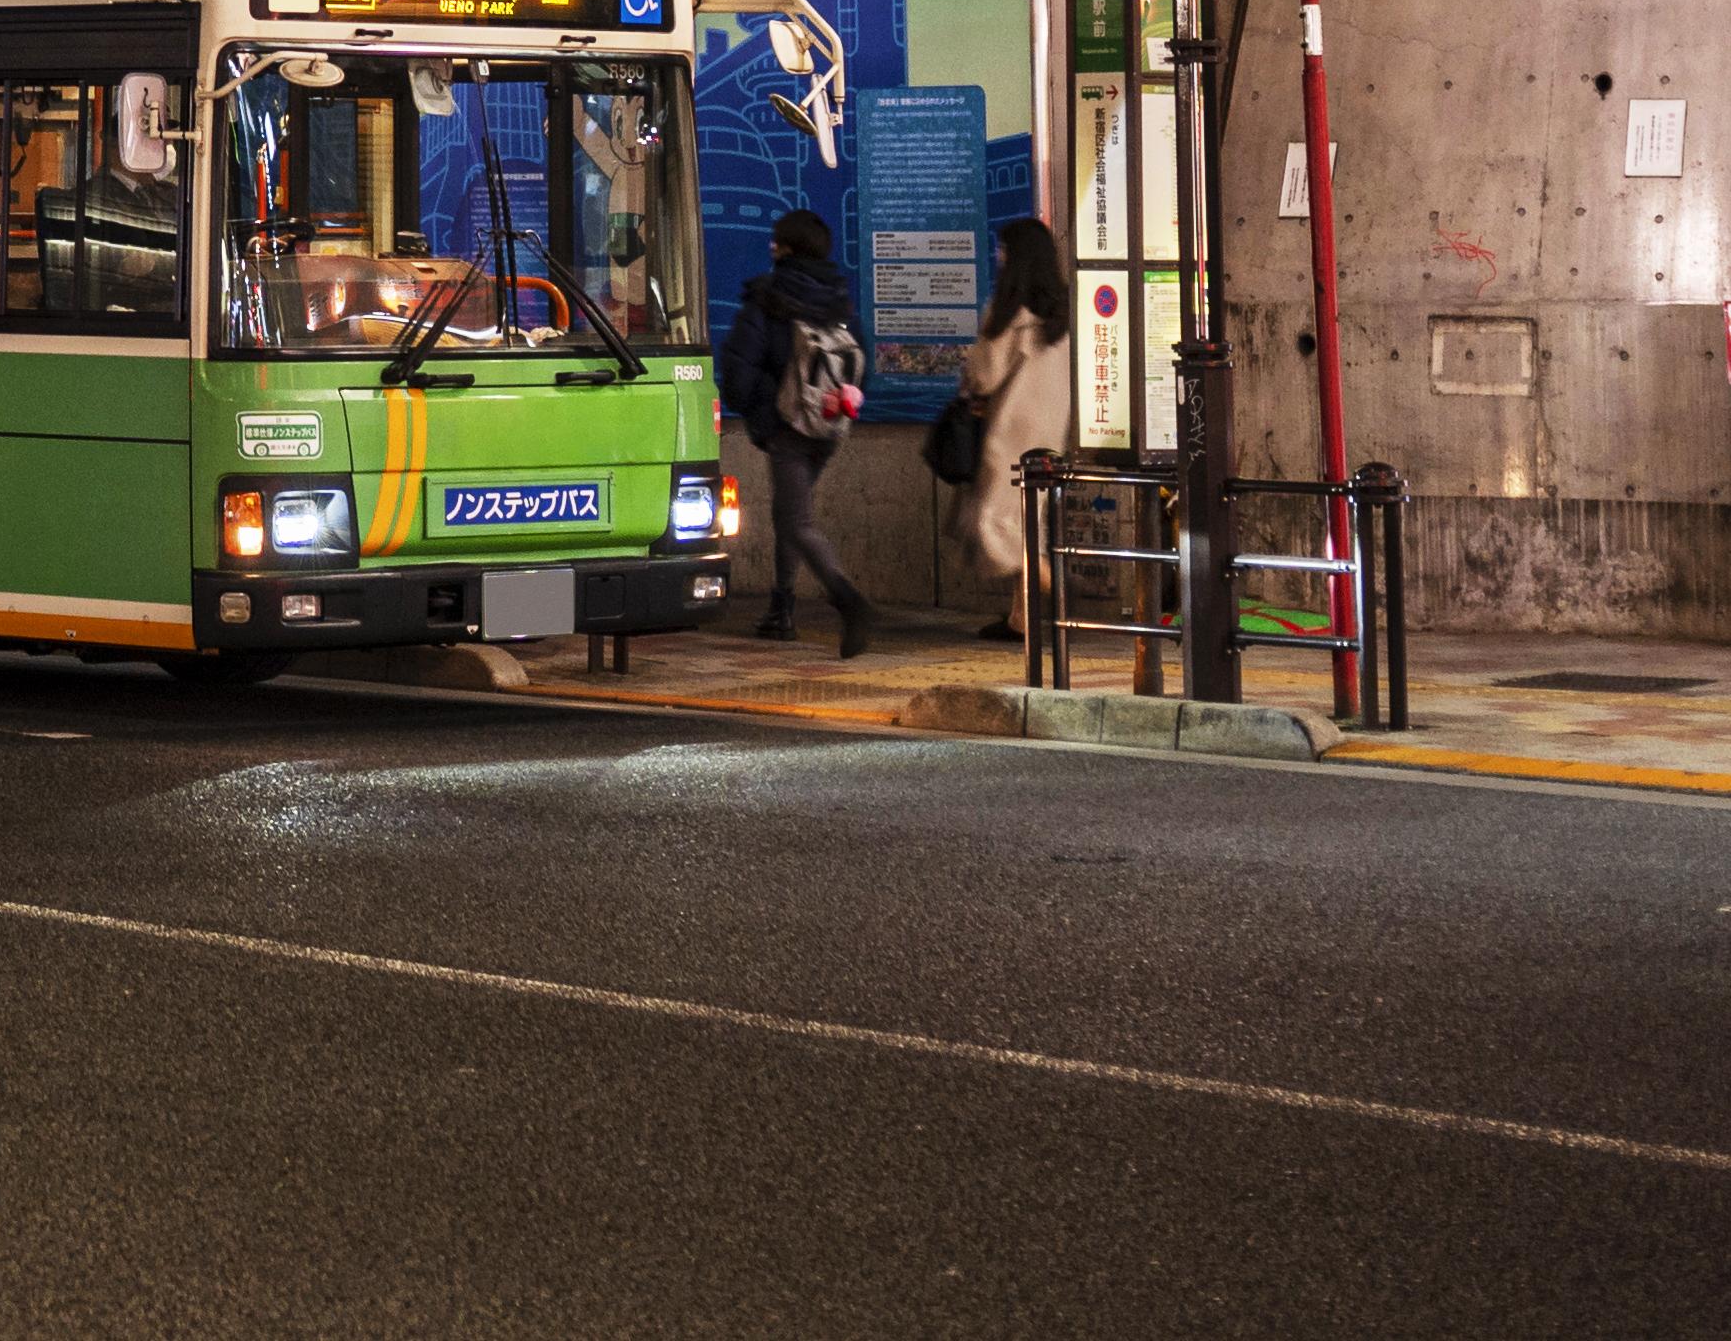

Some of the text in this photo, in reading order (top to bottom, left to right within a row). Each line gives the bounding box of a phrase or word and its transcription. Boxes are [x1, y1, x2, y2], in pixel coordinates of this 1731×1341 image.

[439, 0, 514, 15] UENO PARK
[1111, 113, 1120, 145] つぎは
[1094, 107, 1108, 252] 新宿区社会福祉協議会前
[674, 364, 704, 381] R560
[1094, 324, 1110, 424] 駐停車禁止
[1089, 427, 1126, 438] No Parking
[445, 489, 599, 521] ノンステップバス
